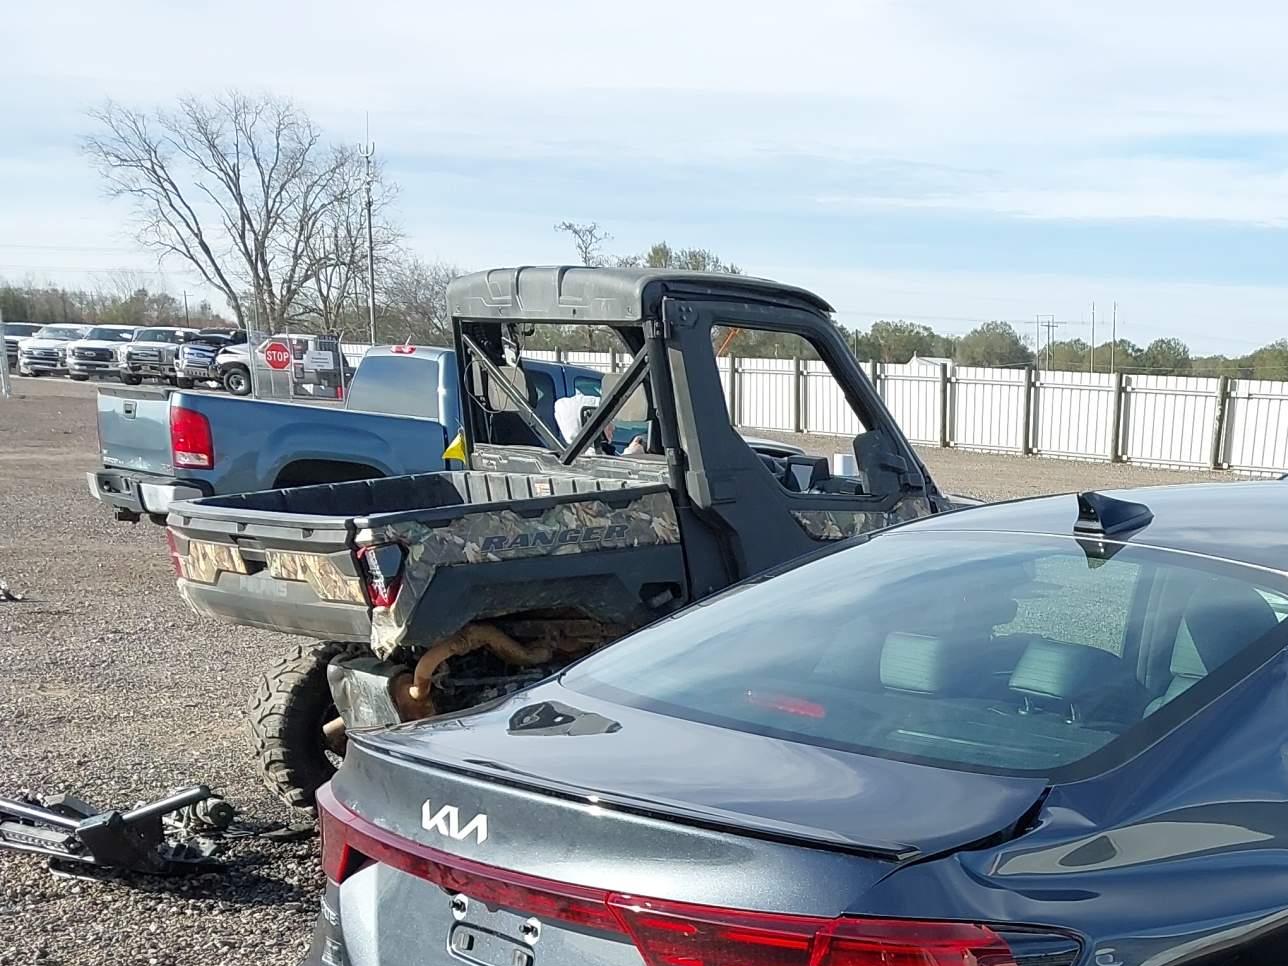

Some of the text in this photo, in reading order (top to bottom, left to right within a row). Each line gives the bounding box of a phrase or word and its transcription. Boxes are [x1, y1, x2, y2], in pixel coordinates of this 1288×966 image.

[266, 350, 290, 362] STOP
[480, 523, 630, 552] RANGER
[421, 799, 488, 845] KIA
